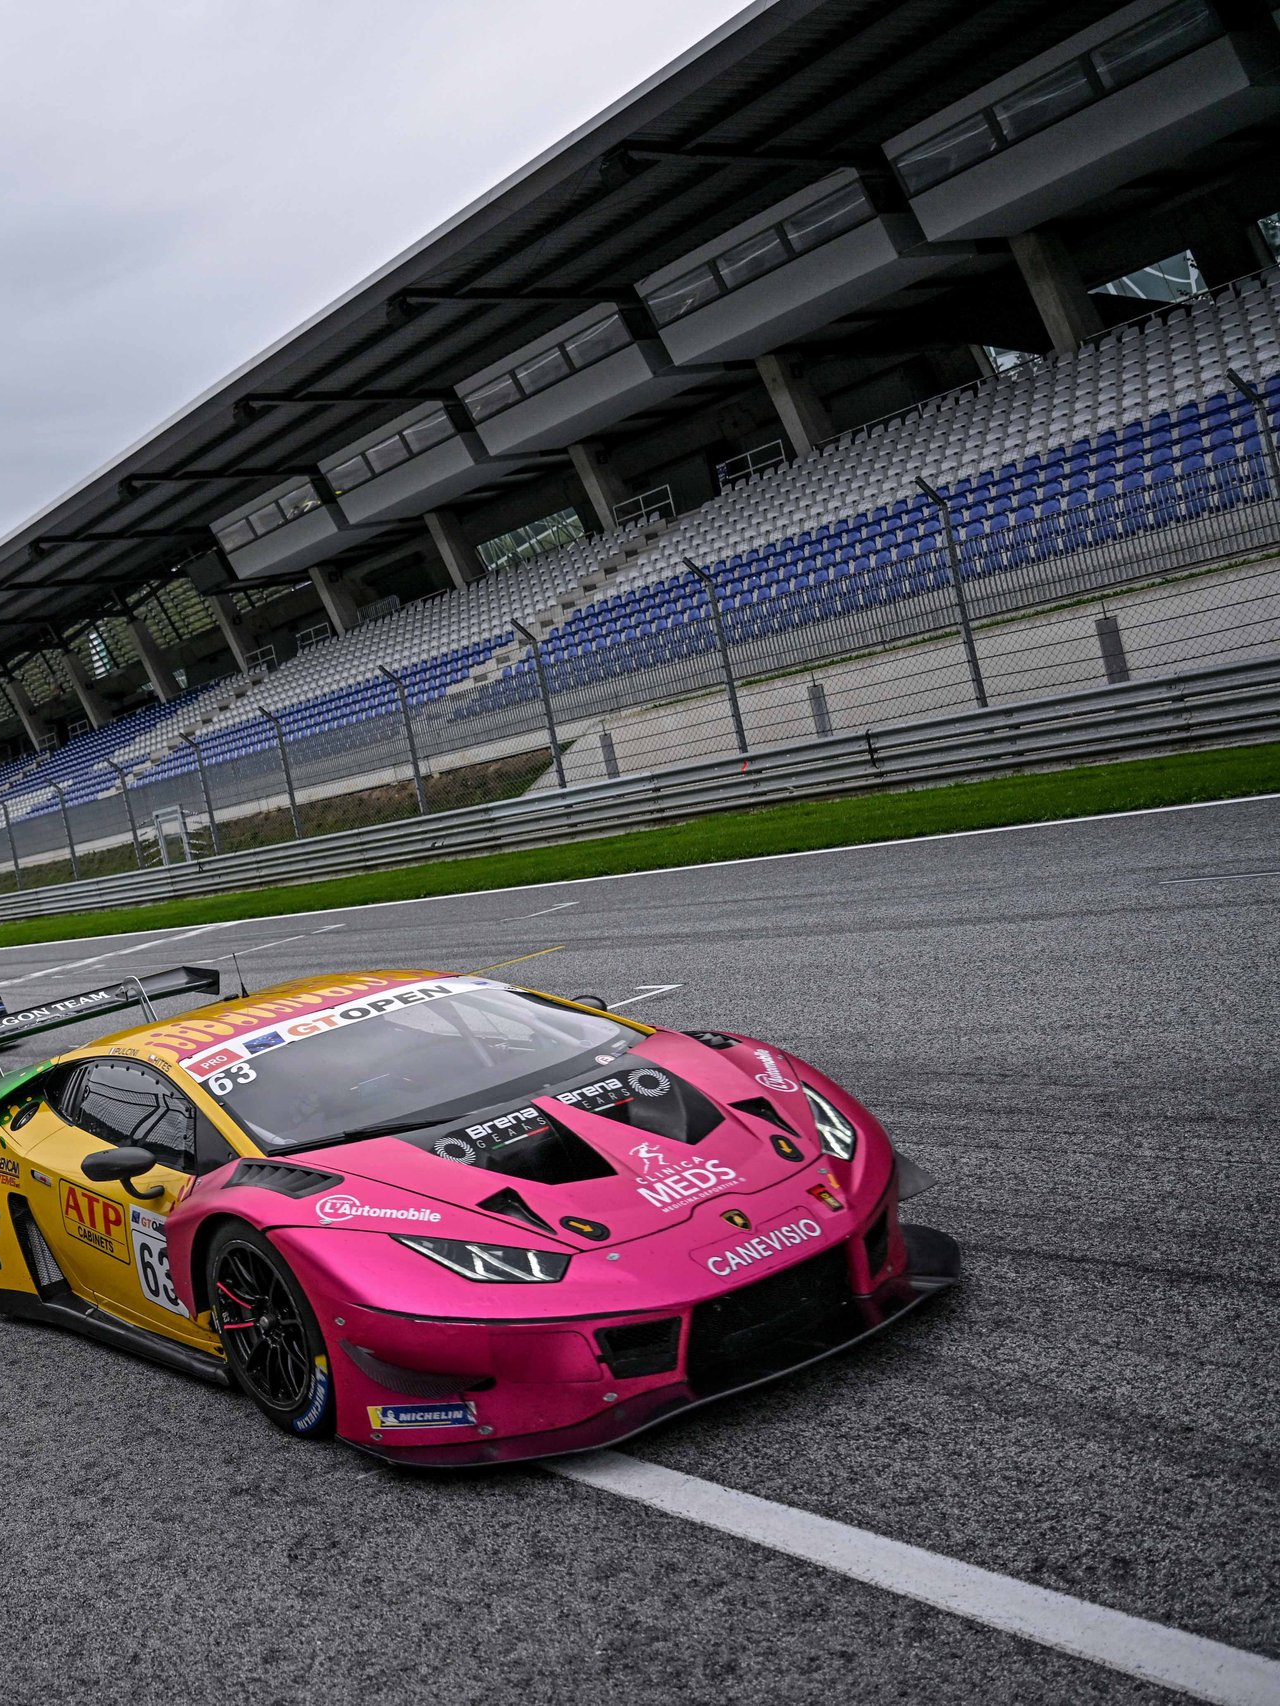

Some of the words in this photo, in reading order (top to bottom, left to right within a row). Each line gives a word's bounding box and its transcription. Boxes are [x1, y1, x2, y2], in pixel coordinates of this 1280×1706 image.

[52, 991, 111, 1011] TEAM
[117, 1047, 140, 1057] PULCINI
[200, 1055, 228, 1070] PRO
[208, 1062, 257, 1096] 63
[556, 1078, 623, 1105] Brena
[582, 1089, 630, 1109] EARS
[466, 1107, 540, 1140] Brena
[636, 1156, 705, 1185] CLINICA
[636, 1159, 737, 1208] MEDS
[65, 1186, 122, 1236] ATP
[662, 1196, 700, 1213] MEDICINA
[699, 1180, 739, 1198] DEPORTIVA
[323, 1202, 441, 1222] L'Automobile
[78, 1226, 114, 1253] CABINETS
[707, 1218, 821, 1276] CANEVISIO
[140, 1242, 179, 1306] 63
[297, 1383, 326, 1430] MICHELIN
[399, 1410, 463, 1421] MICHELIN
